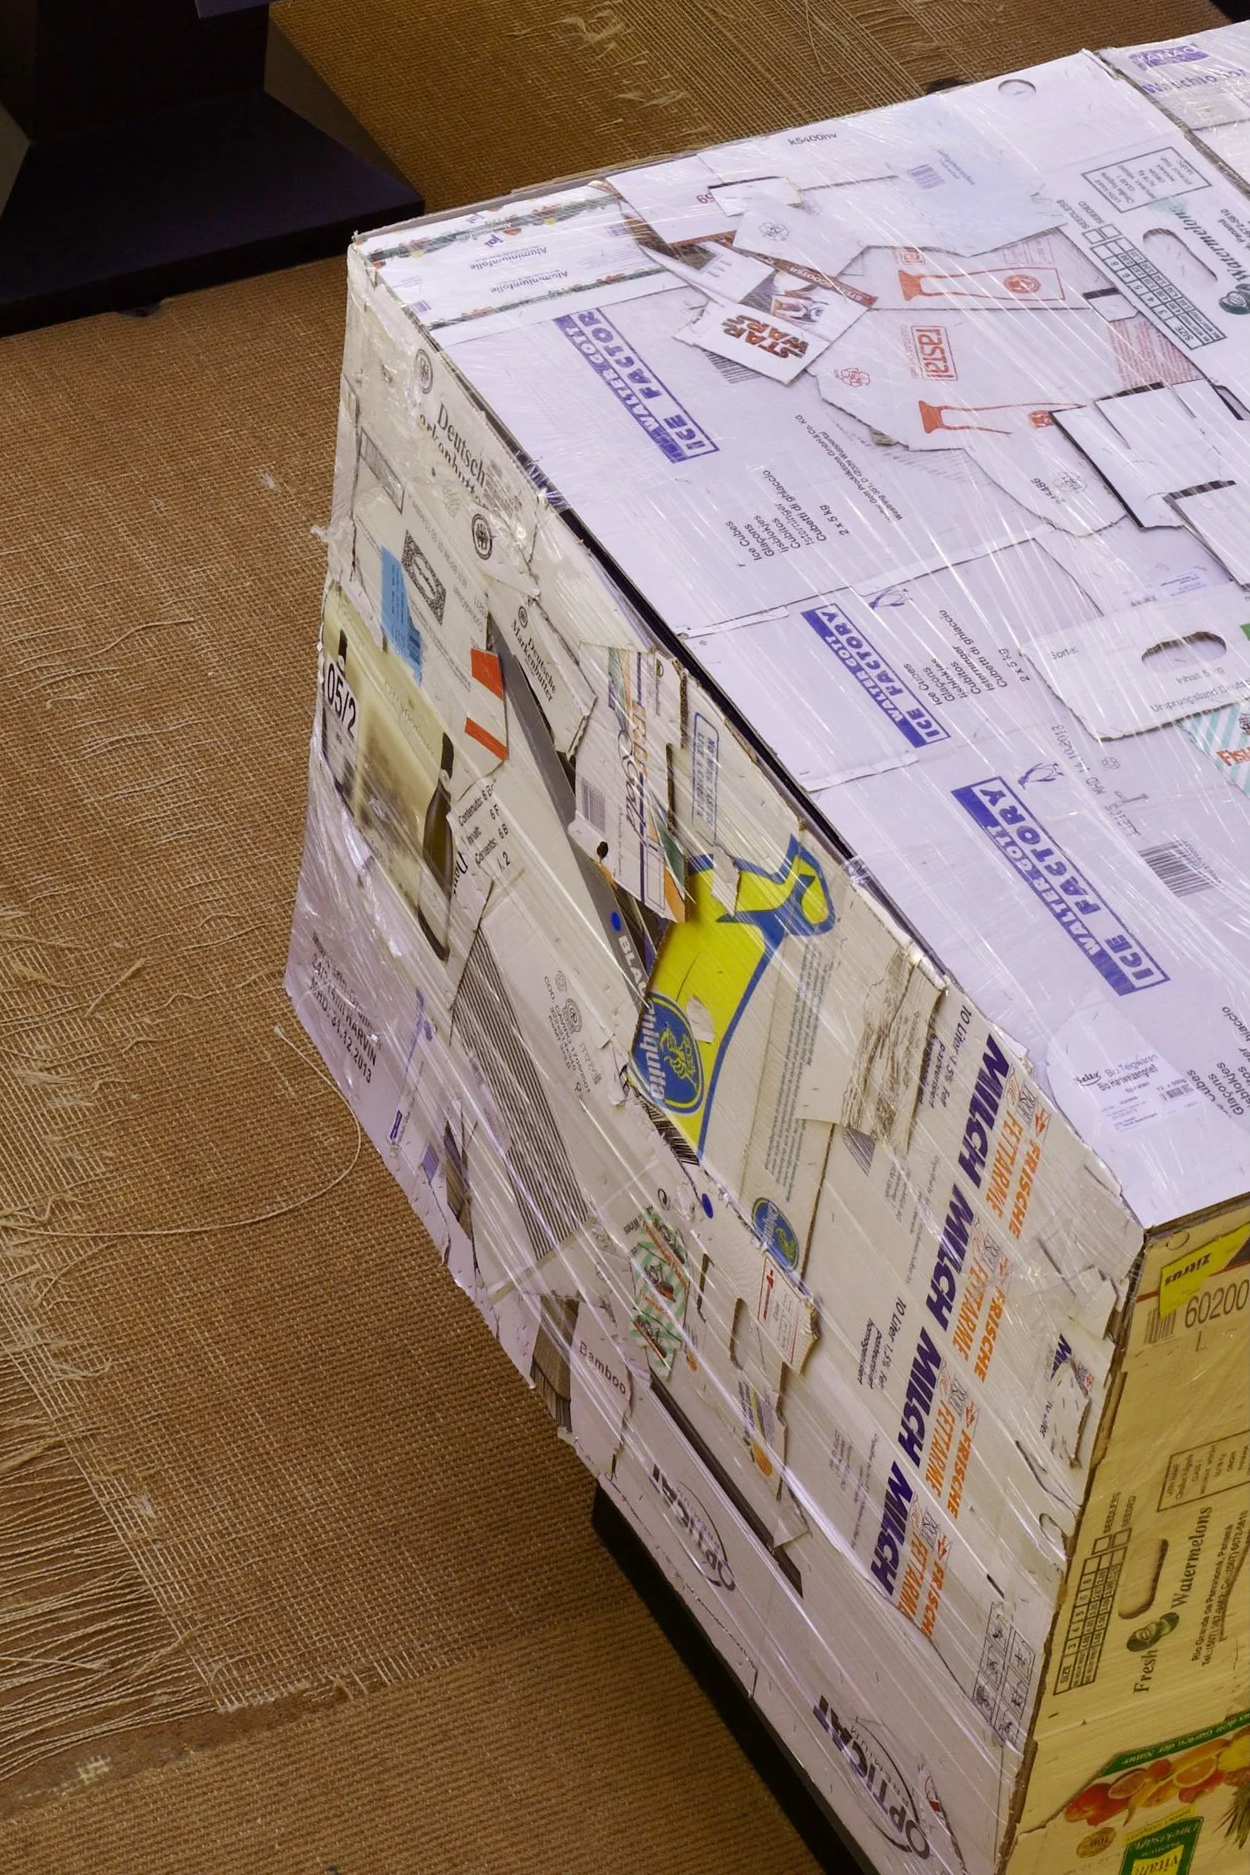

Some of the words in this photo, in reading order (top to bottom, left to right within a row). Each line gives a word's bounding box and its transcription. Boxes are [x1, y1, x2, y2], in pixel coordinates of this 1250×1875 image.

[470, 247, 548, 271] Aluminiumfolie
[489, 270, 569, 295] Aluminiumfolie
[926, 329, 956, 378] rastal
[665, 413, 707, 451] ICE
[762, 466, 795, 506] ghiaccio
[724, 518, 751, 550] Cubes
[743, 520, 776, 560] Glaçons
[771, 515, 801, 552] Cubitos
[798, 508, 828, 545] Cubetti
[745, 545, 762, 564] Ice
[511, 618, 555, 704] Markenbutter
[525, 636, 557, 695] Deutsche
[819, 607, 905, 703] FACTORY
[949, 658, 982, 698] Cubitos
[978, 653, 1008, 691] Cubetti
[922, 663, 956, 706] Glaçons
[905, 707, 936, 740] ICE
[977, 783, 1101, 916] FACTORY
[1029, 886, 1099, 957] WALTER
[1105, 934, 1156, 982] ICE
[961, 1034, 1010, 1189] MILCH
[986, 1110, 1025, 1220] FETTARME
[1009, 1141, 1041, 1239] FRISCHE
[927, 1184, 974, 1332] MILCH
[1163, 1252, 1211, 1288] zitrus
[953, 1261, 988, 1361] FETTARME
[973, 1290, 1006, 1384] FRISCHE
[898, 1327, 943, 1468] MILCH
[925, 1407, 956, 1497] FETTARME
[947, 1431, 973, 1519] FRISCHE
[871, 1458, 913, 1596] MILCH
[1171, 1507, 1213, 1609] Watermelons
[1133, 1649, 1158, 1694] Fresh
[812, 1695, 930, 1860] OPTICAT
